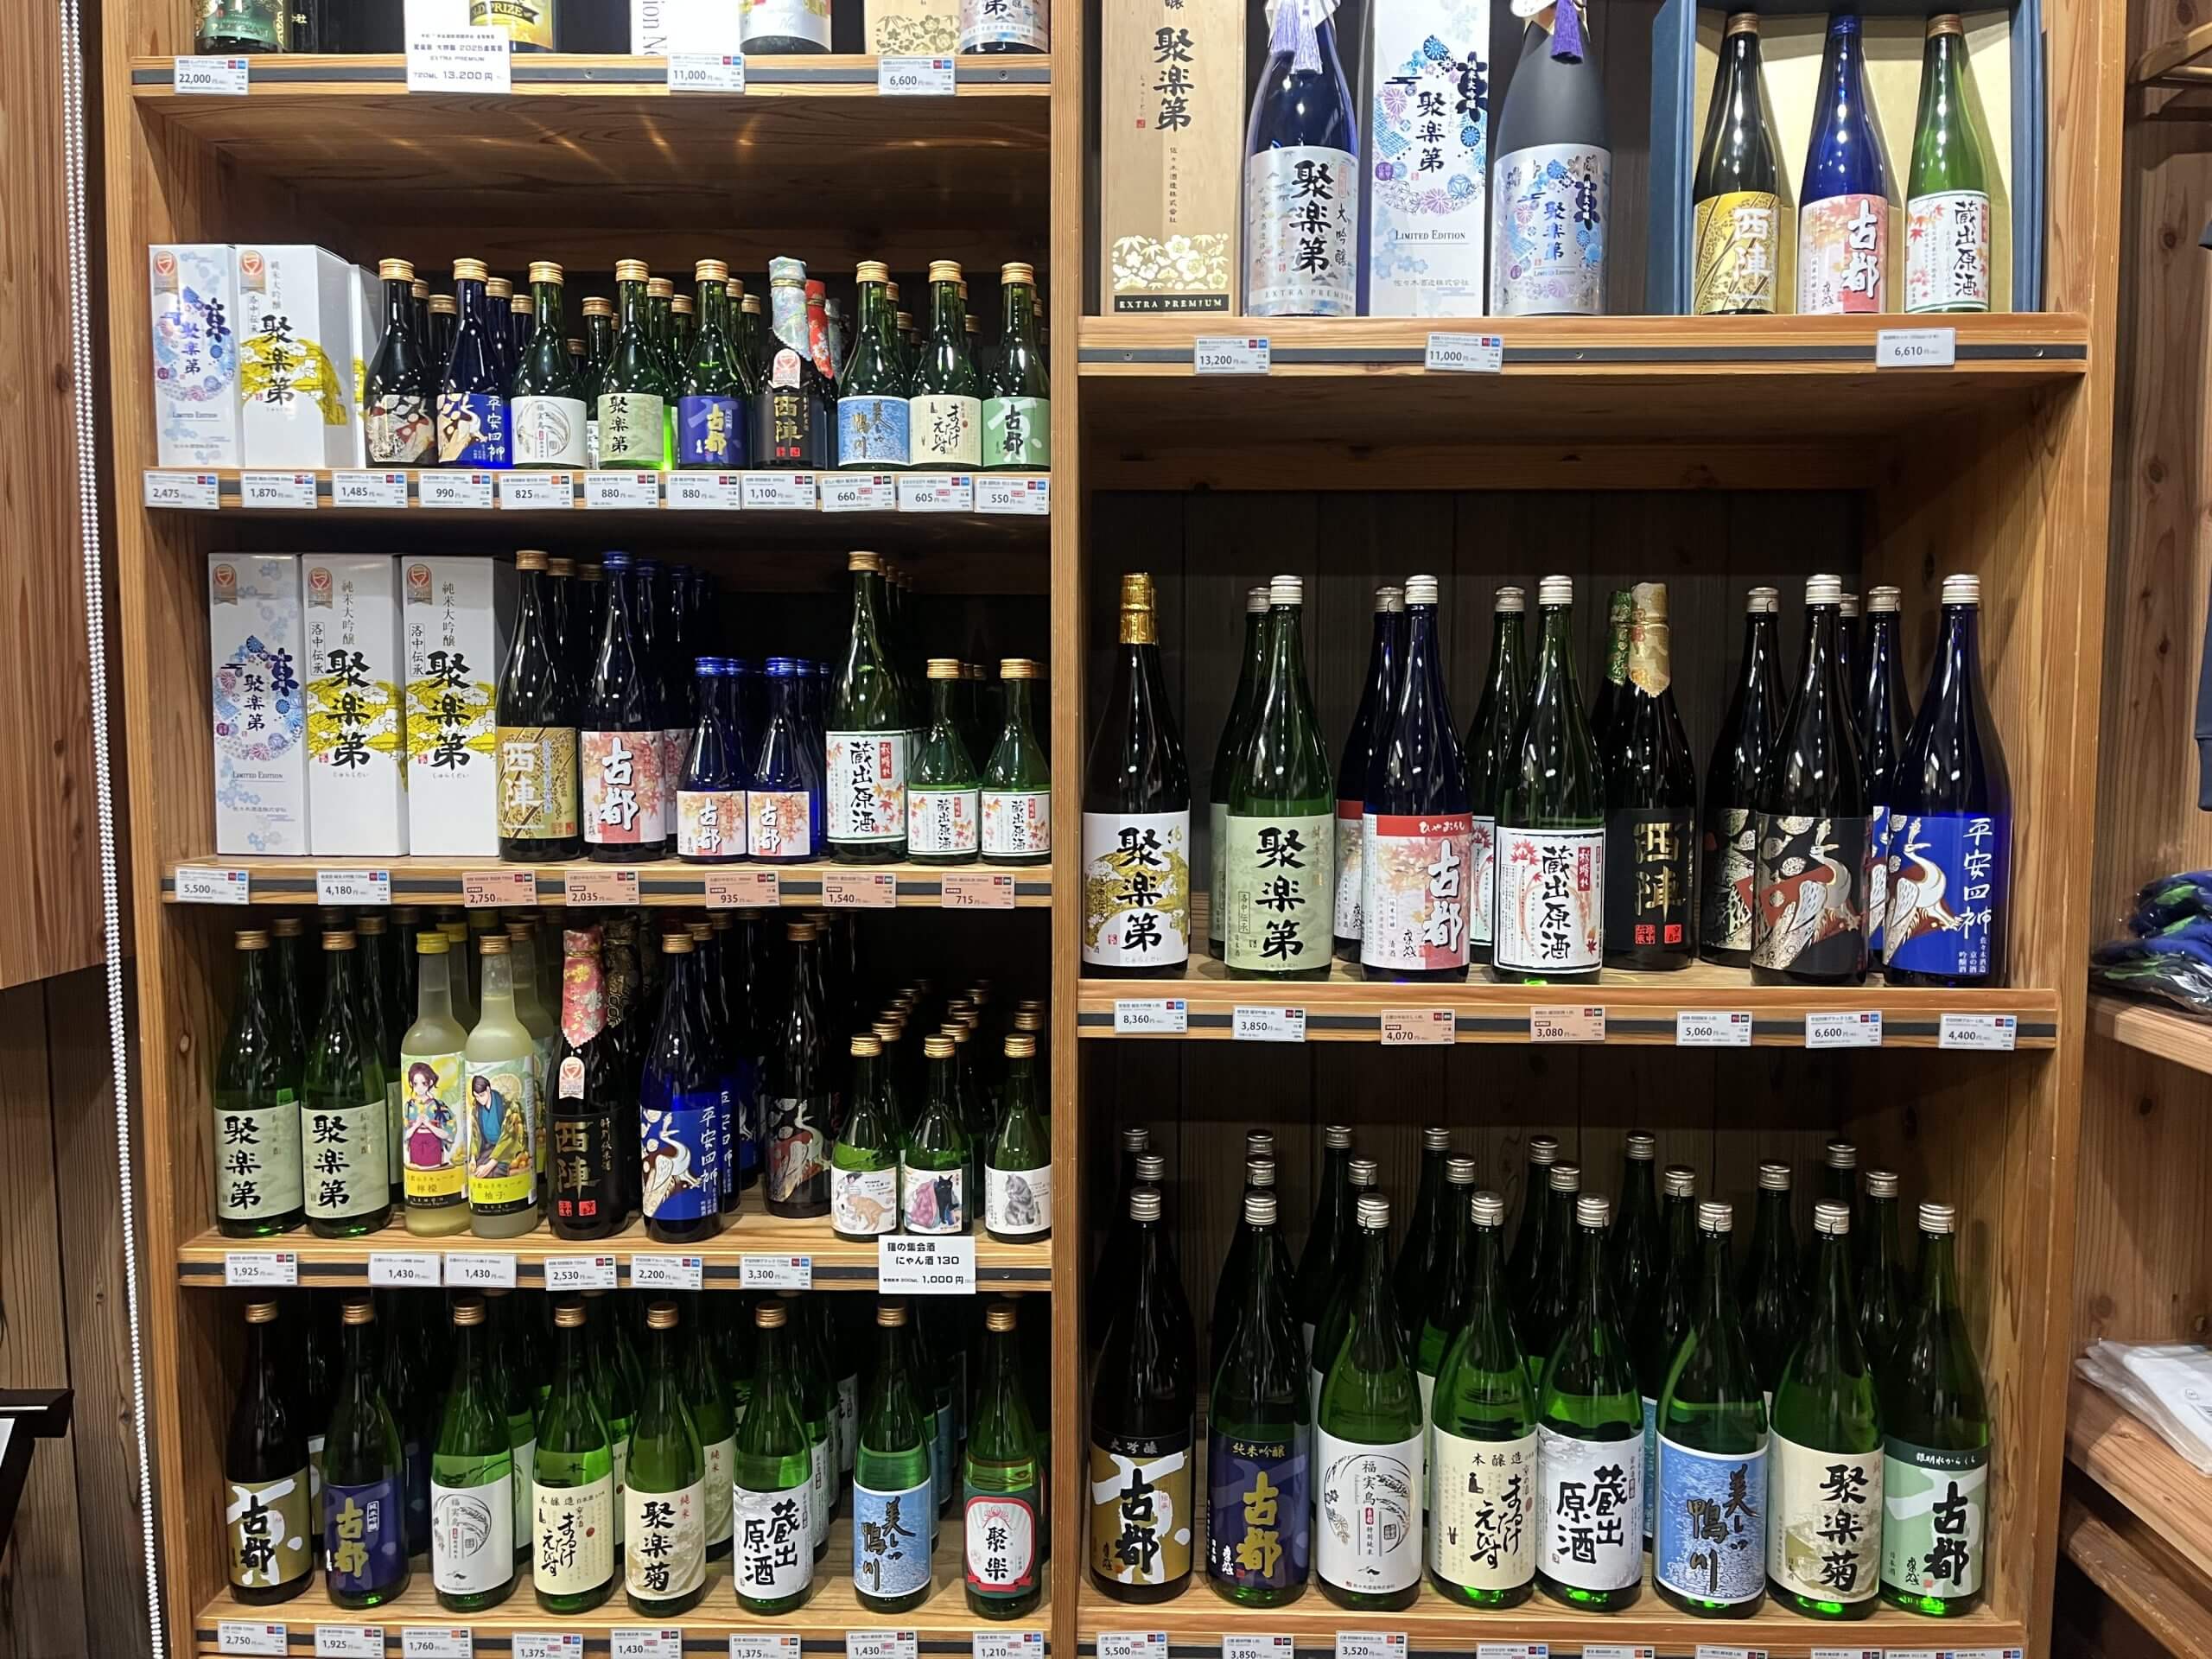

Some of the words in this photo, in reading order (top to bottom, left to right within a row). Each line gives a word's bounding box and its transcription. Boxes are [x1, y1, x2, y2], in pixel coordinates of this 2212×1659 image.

[1154, 27, 1195, 132] 聚楽第
[1415, 91, 1448, 174] 聚楽第
[1289, 159, 1335, 275] 聚楽第
[1395, 230, 1427, 242] LIMITED
[1431, 230, 1466, 242] EDITION
[1727, 207, 1772, 287] 西陣
[1840, 199, 1881, 299] 古都
[1953, 200, 1978, 297] 蔵出原酒
[1119, 300, 1159, 309] EXTRA
[1165, 298, 1222, 309] PREMIUM
[260, 314, 295, 406] 聚楽第
[609, 395, 630, 454] 聚楽第
[705, 403, 728, 456] 古都
[773, 396, 804, 447] 西陣
[1003, 404, 1024, 455] 古都
[312, 624, 325, 675] 洛中伝承
[342, 580, 355, 646] 純米大吟醸
[411, 625, 424, 677] 洛中伝承
[442, 581, 456, 648] 純米大吟醸
[243, 673, 266, 733] 聚楽第
[325, 649, 372, 771] 聚楽第
[425, 650, 472, 772] 聚楽第
[502, 741, 543, 816] 西陣
[600, 736, 641, 832] 古都
[850, 741, 876, 833] 蔵出原酒
[697, 798, 722, 855] 古都
[760, 798, 782, 855] 古都
[937, 798, 951, 851] 蔵出原酒
[1011, 799, 1026, 852] 蔵出原酒
[1116, 826, 1164, 952] 聚楽第
[1255, 826, 1307, 962] 聚楽第
[1422, 837, 1465, 955] 古都
[1540, 845, 1574, 961] 蔵出原酒
[1634, 823, 1686, 922] 西陣
[1957, 817, 1993, 940] 平安四神
[224, 1115, 262, 1210] 聚楽第
[313, 1115, 351, 1210] 聚楽第
[699, 1106, 719, 1193] 平安四神
[895, 1255, 934, 1266] にゃん酒
[937, 1255, 960, 1265] 130
[1231, 1442, 1287, 1459] 純米吟醸
[1472, 1451, 1523, 1467] 本醸造
[240, 1494, 276, 1573] 古都
[334, 1497, 370, 1579] 古都
[640, 1501, 677, 1592] 聚楽菊
[766, 1498, 800, 1568] 蔵出
[1115, 1467, 1160, 1573] 古都
[1236, 1471, 1282, 1579] 古都
[1556, 1481, 1597, 1565] 原酒
[1588, 1464, 1628, 1548] 蔵出
[1687, 1498, 1730, 1594] 鴨川
[1721, 1463, 1763, 1551] 美しい
[1816, 1464, 1869, 1593] 聚楽菊
[1923, 1480, 1970, 1587] 古都
[744, 1518, 776, 1586] 原酒
[861, 1522, 889, 1592] 鴨川
